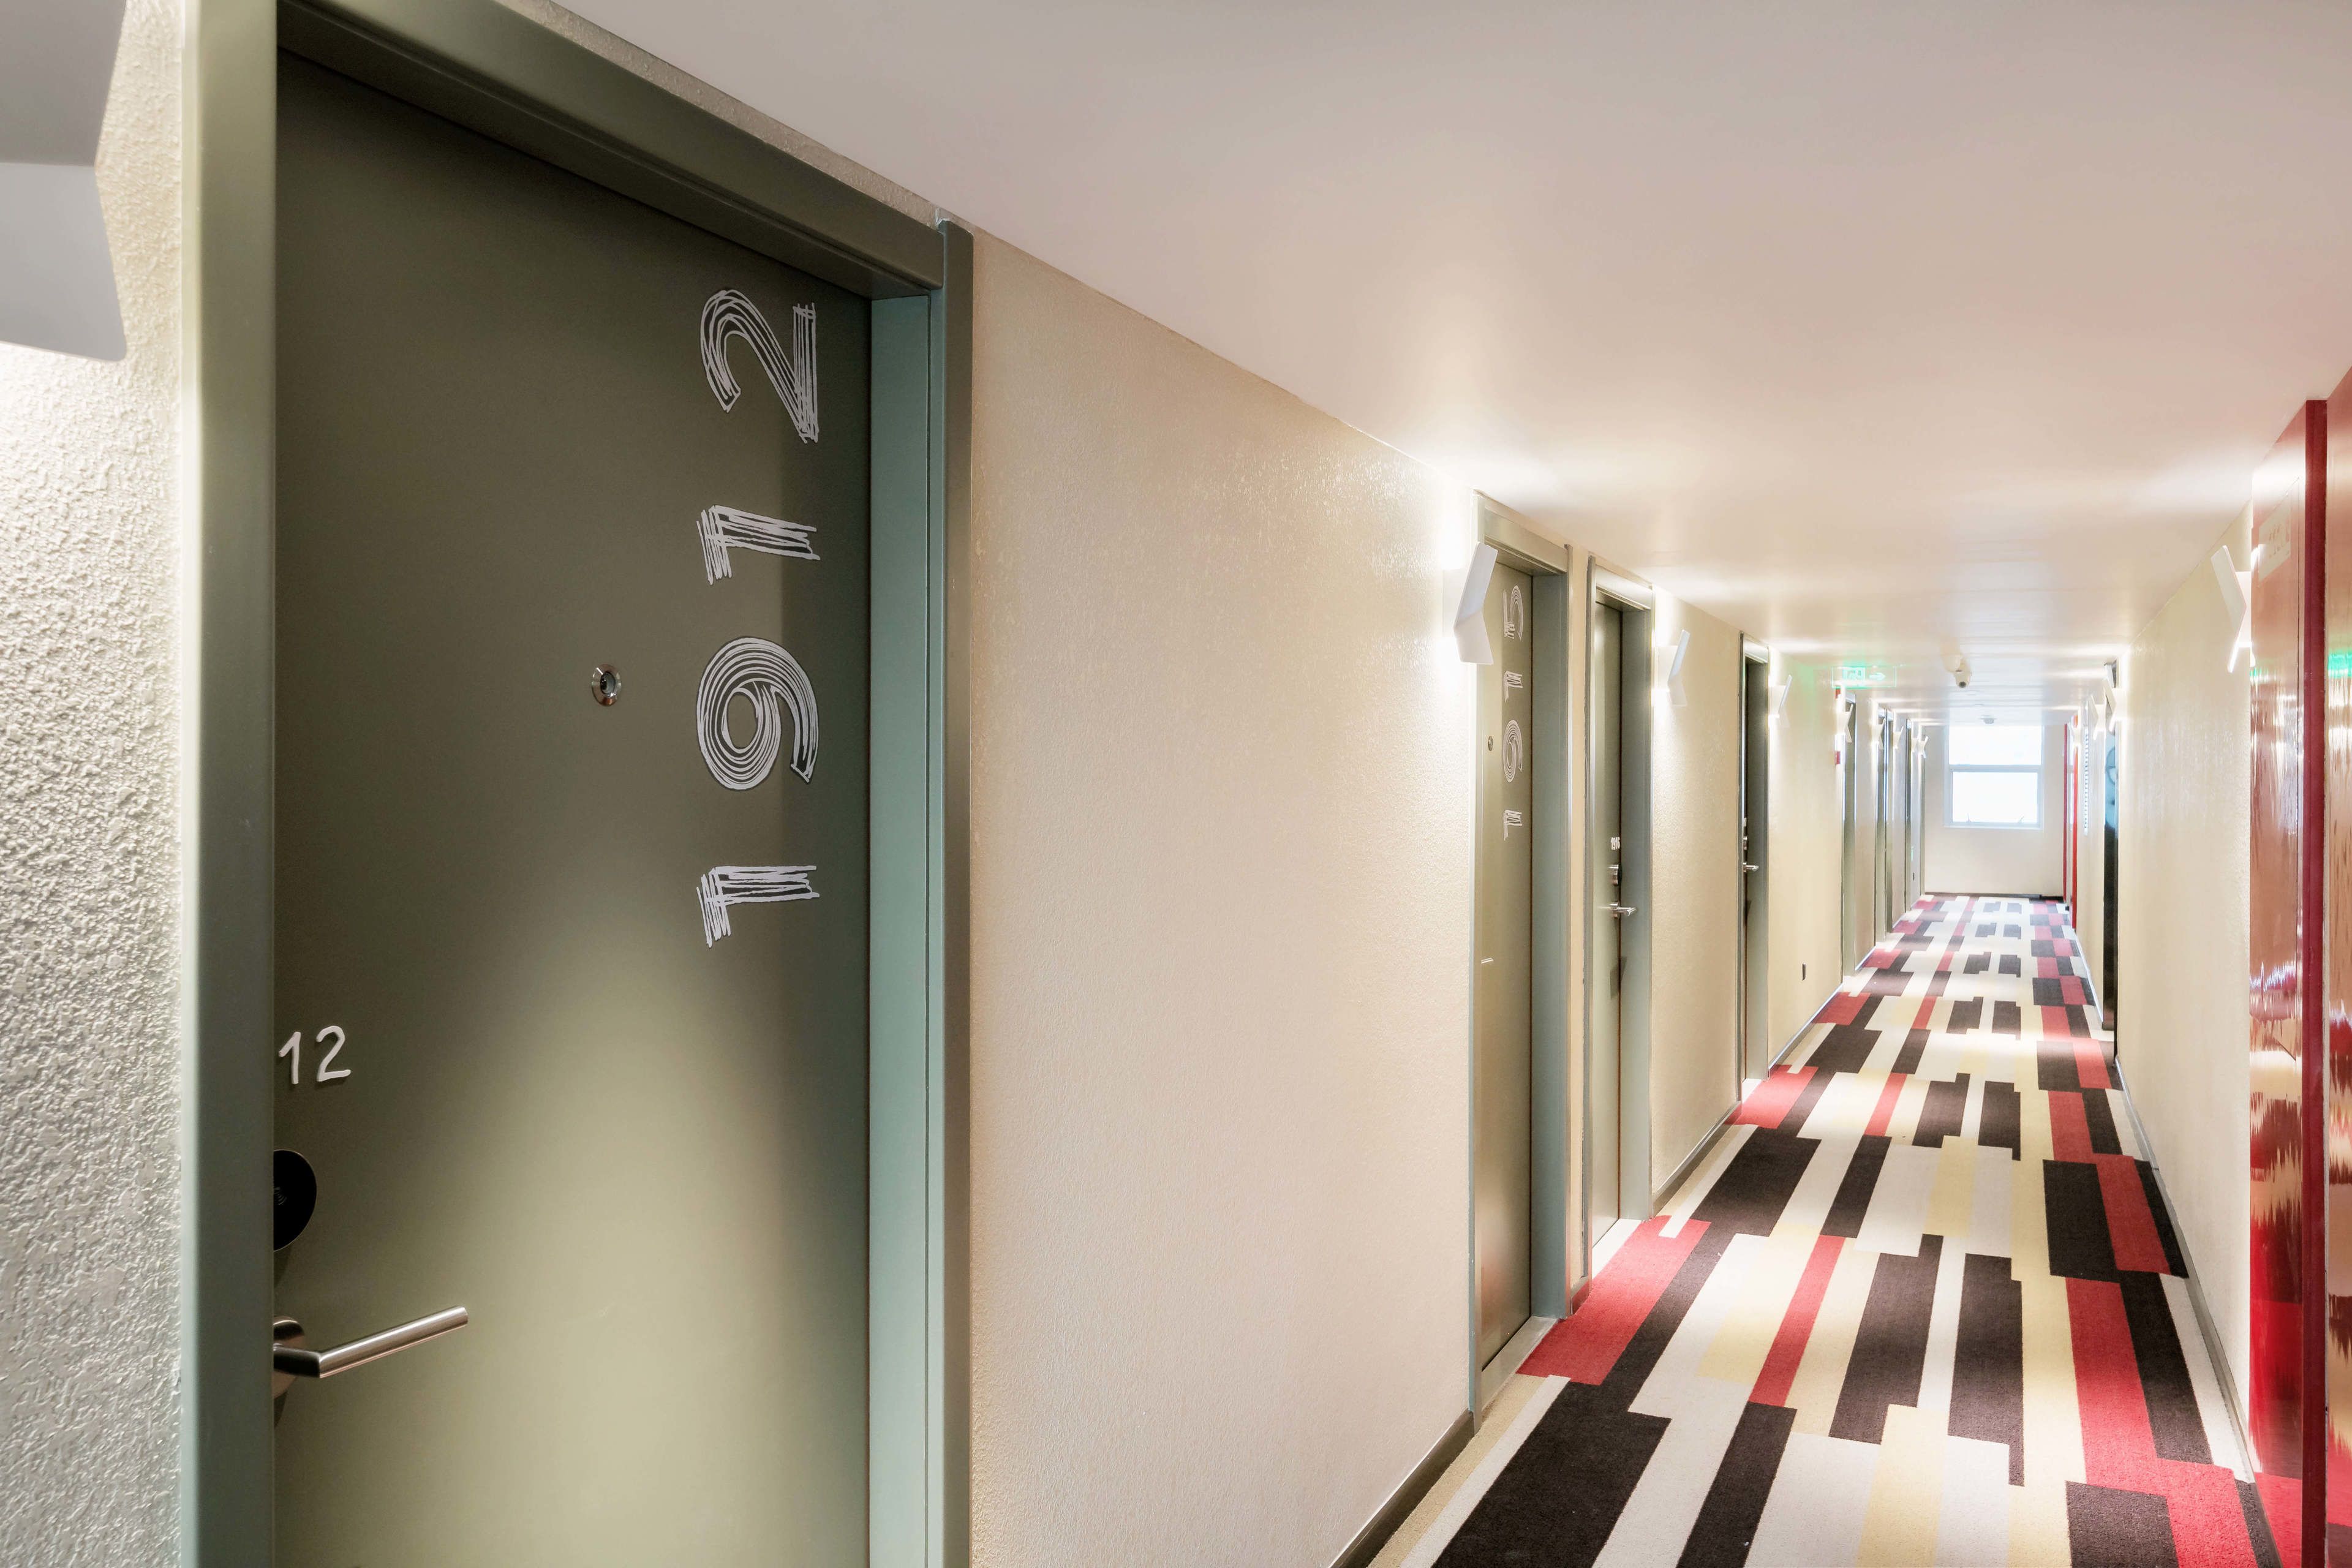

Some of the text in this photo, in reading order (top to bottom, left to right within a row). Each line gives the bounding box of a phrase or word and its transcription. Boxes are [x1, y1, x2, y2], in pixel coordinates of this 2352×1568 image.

[695, 288, 821, 948] 1912
[1502, 585, 1524, 842] 1915
[279, 1025, 352, 1084] 12
